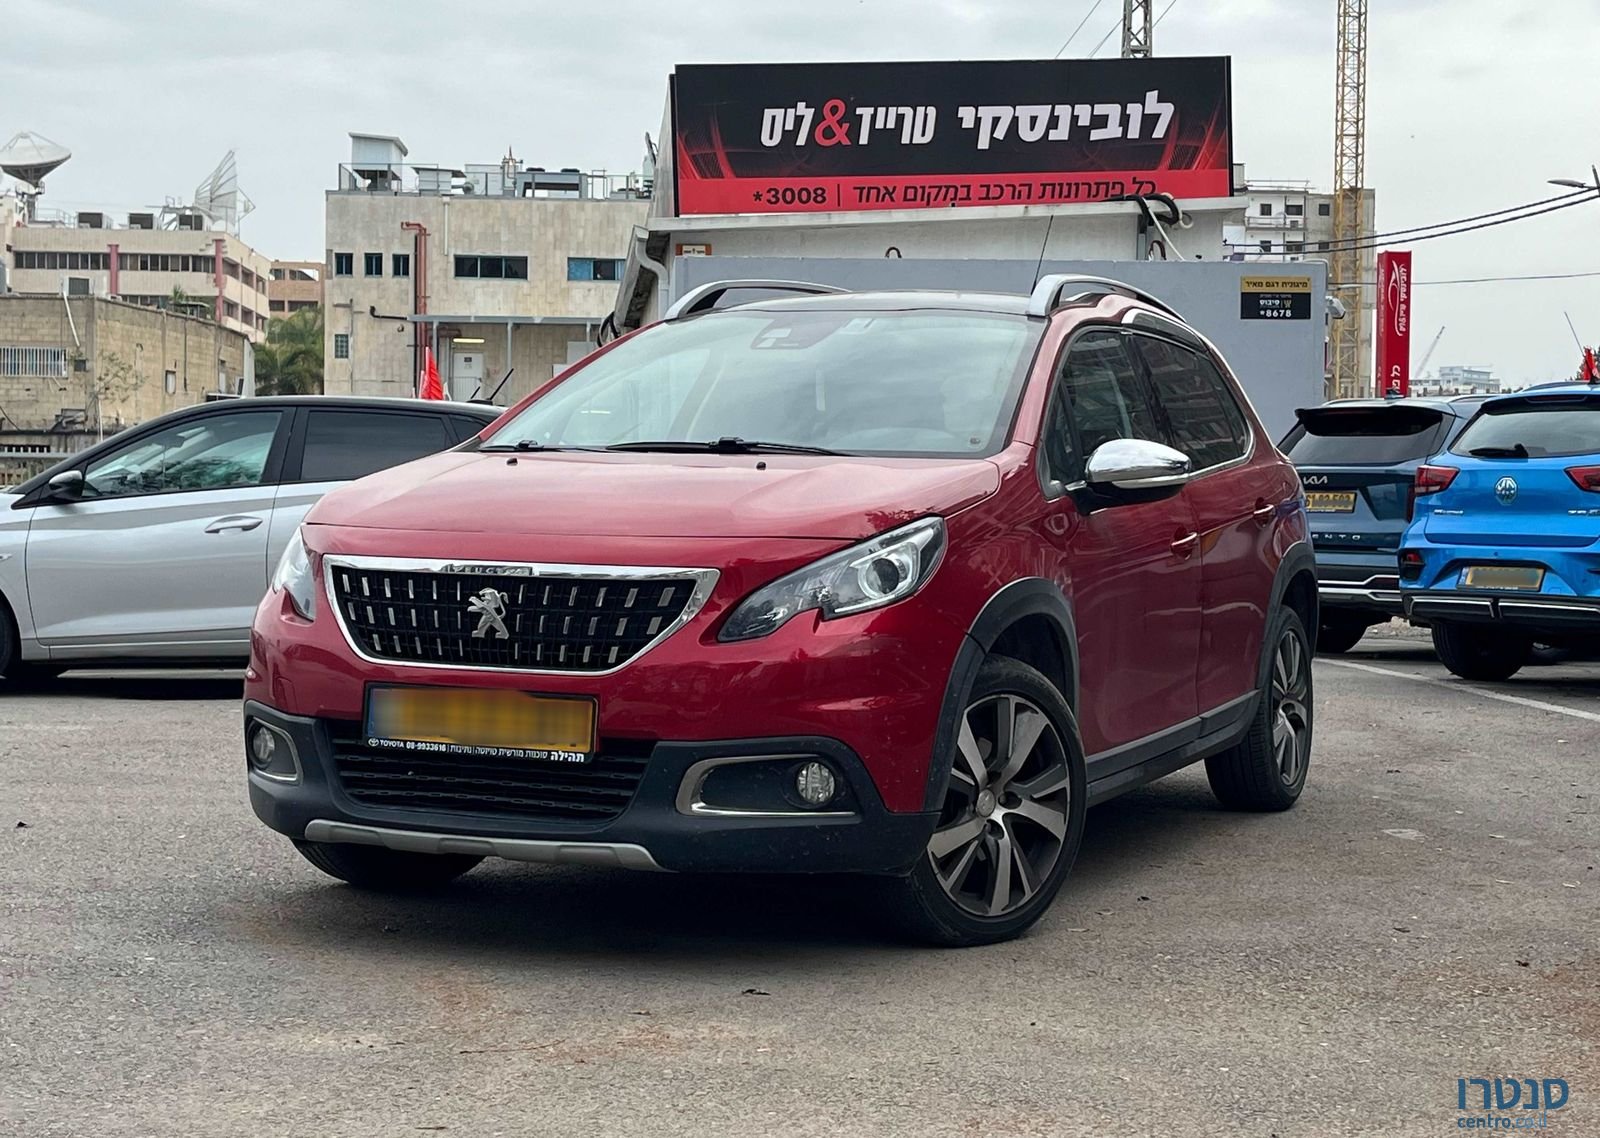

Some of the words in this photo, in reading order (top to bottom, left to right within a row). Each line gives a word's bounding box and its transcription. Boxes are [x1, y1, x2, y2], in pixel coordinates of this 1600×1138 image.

[957, 89, 1175, 150] לובינסקי
[852, 186, 897, 203] אחד
[902, 184, 972, 206] במקום
[978, 183, 1033, 201] הרכב
[1038, 181, 1125, 199] פתרונות
[1131, 176, 1157, 196] כל
[380, 739, 404, 748] TOYOTA
[551, 750, 585, 762] תהילה
